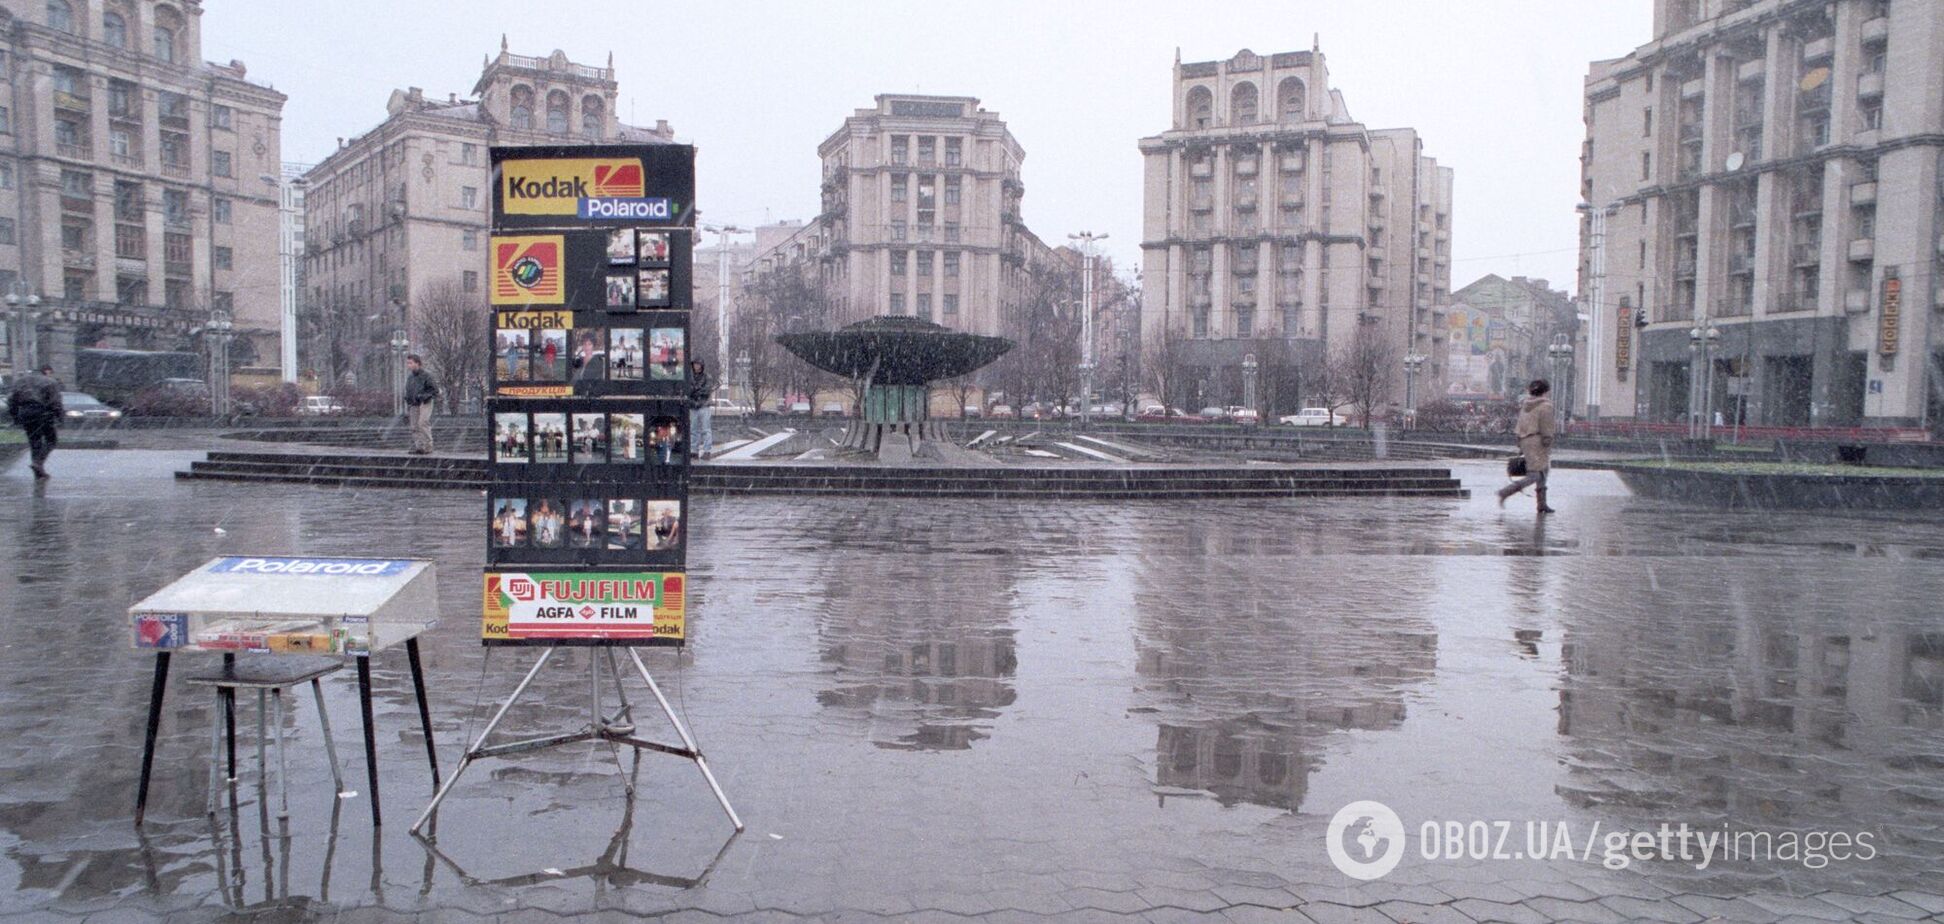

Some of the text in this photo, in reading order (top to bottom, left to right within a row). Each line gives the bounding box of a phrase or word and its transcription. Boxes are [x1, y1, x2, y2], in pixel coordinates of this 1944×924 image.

[509, 176, 588, 199] Kodak
[588, 199, 667, 217] Polaroid
[505, 312, 566, 329] Kodak
[230, 558, 391, 575] Polaroid
[540, 580, 655, 600] FUJIFILM
[536, 607, 575, 619] AGFA
[601, 607, 638, 619] FILM
[486, 624, 508, 634] Kod
[652, 624, 680, 635] odak
